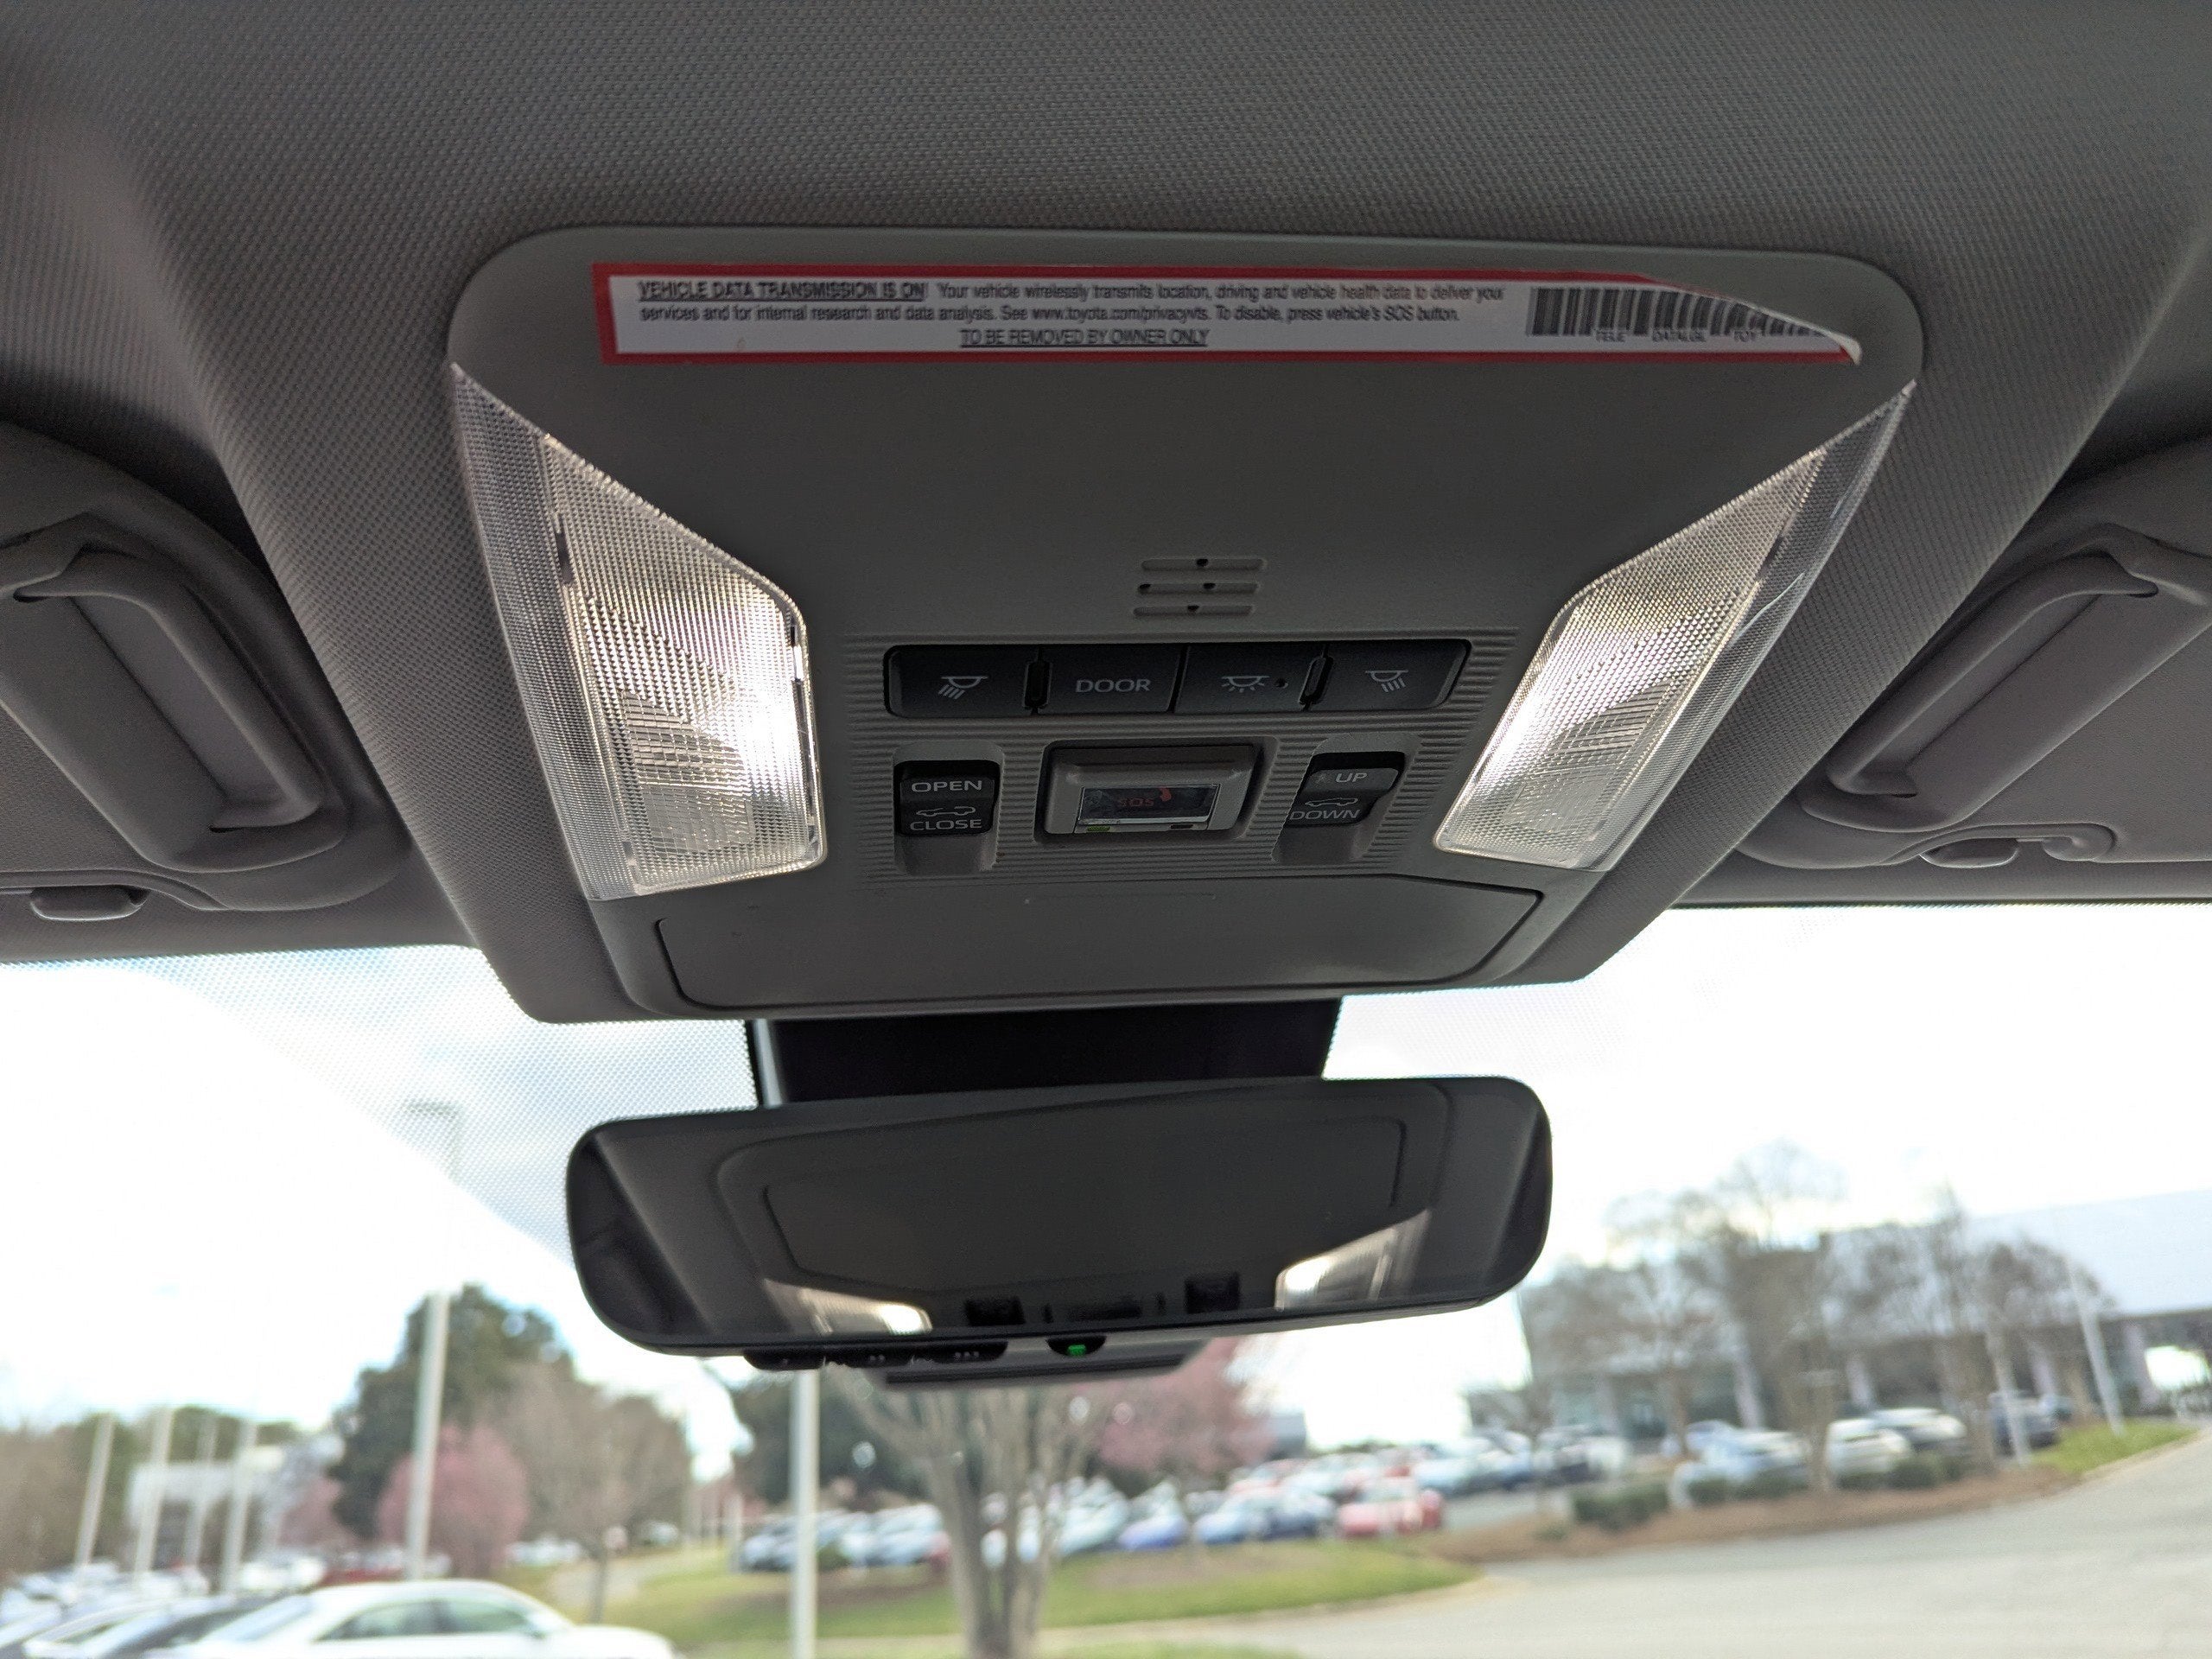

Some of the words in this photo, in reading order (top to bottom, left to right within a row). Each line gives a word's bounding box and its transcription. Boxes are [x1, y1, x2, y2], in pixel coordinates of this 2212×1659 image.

[639, 281, 708, 300] VEHICLE
[711, 281, 753, 300] DATA
[757, 281, 878, 300] TRANSMISSION
[882, 281, 898, 299] IS
[938, 283, 969, 299] Your
[974, 283, 1021, 299] vehicle
[1024, 283, 1090, 303] wirelessly
[1092, 283, 1154, 299] transmits
[1216, 283, 1261, 303] driving
[1262, 284, 1288, 300] and
[1290, 284, 1337, 300] vehicle
[1339, 284, 1381, 300] health
[1382, 284, 1412, 300] data
[1414, 285, 1428, 300] to
[1430, 284, 1474, 301] deliver
[1474, 288, 1505, 304] your
[640, 306, 701, 321] services
[702, 306, 730, 321] and
[732, 306, 753, 321] for
[755, 305, 809, 321] internal
[810, 305, 872, 321] research
[874, 305, 902, 321] and
[904, 305, 935, 321] data
[1000, 305, 1028, 321] See
[1216, 305, 1232, 321] To
[1285, 308, 1324, 325] press
[1382, 305, 1414, 321] SOS
[960, 328, 982, 345] TO
[985, 328, 1006, 345] BE
[1008, 328, 1084, 345] REMOVED
[1086, 328, 1109, 345] BY
[1110, 328, 1167, 345] OWNER
[1168, 328, 1210, 345] ONLY
[1075, 678, 1152, 693] DOOR
[1335, 772, 1368, 784] UP
[911, 779, 983, 793] OPEN
[1118, 798, 1154, 808] SOS
[1290, 808, 1361, 822] DOWN
[910, 818, 982, 832] CLOSE
